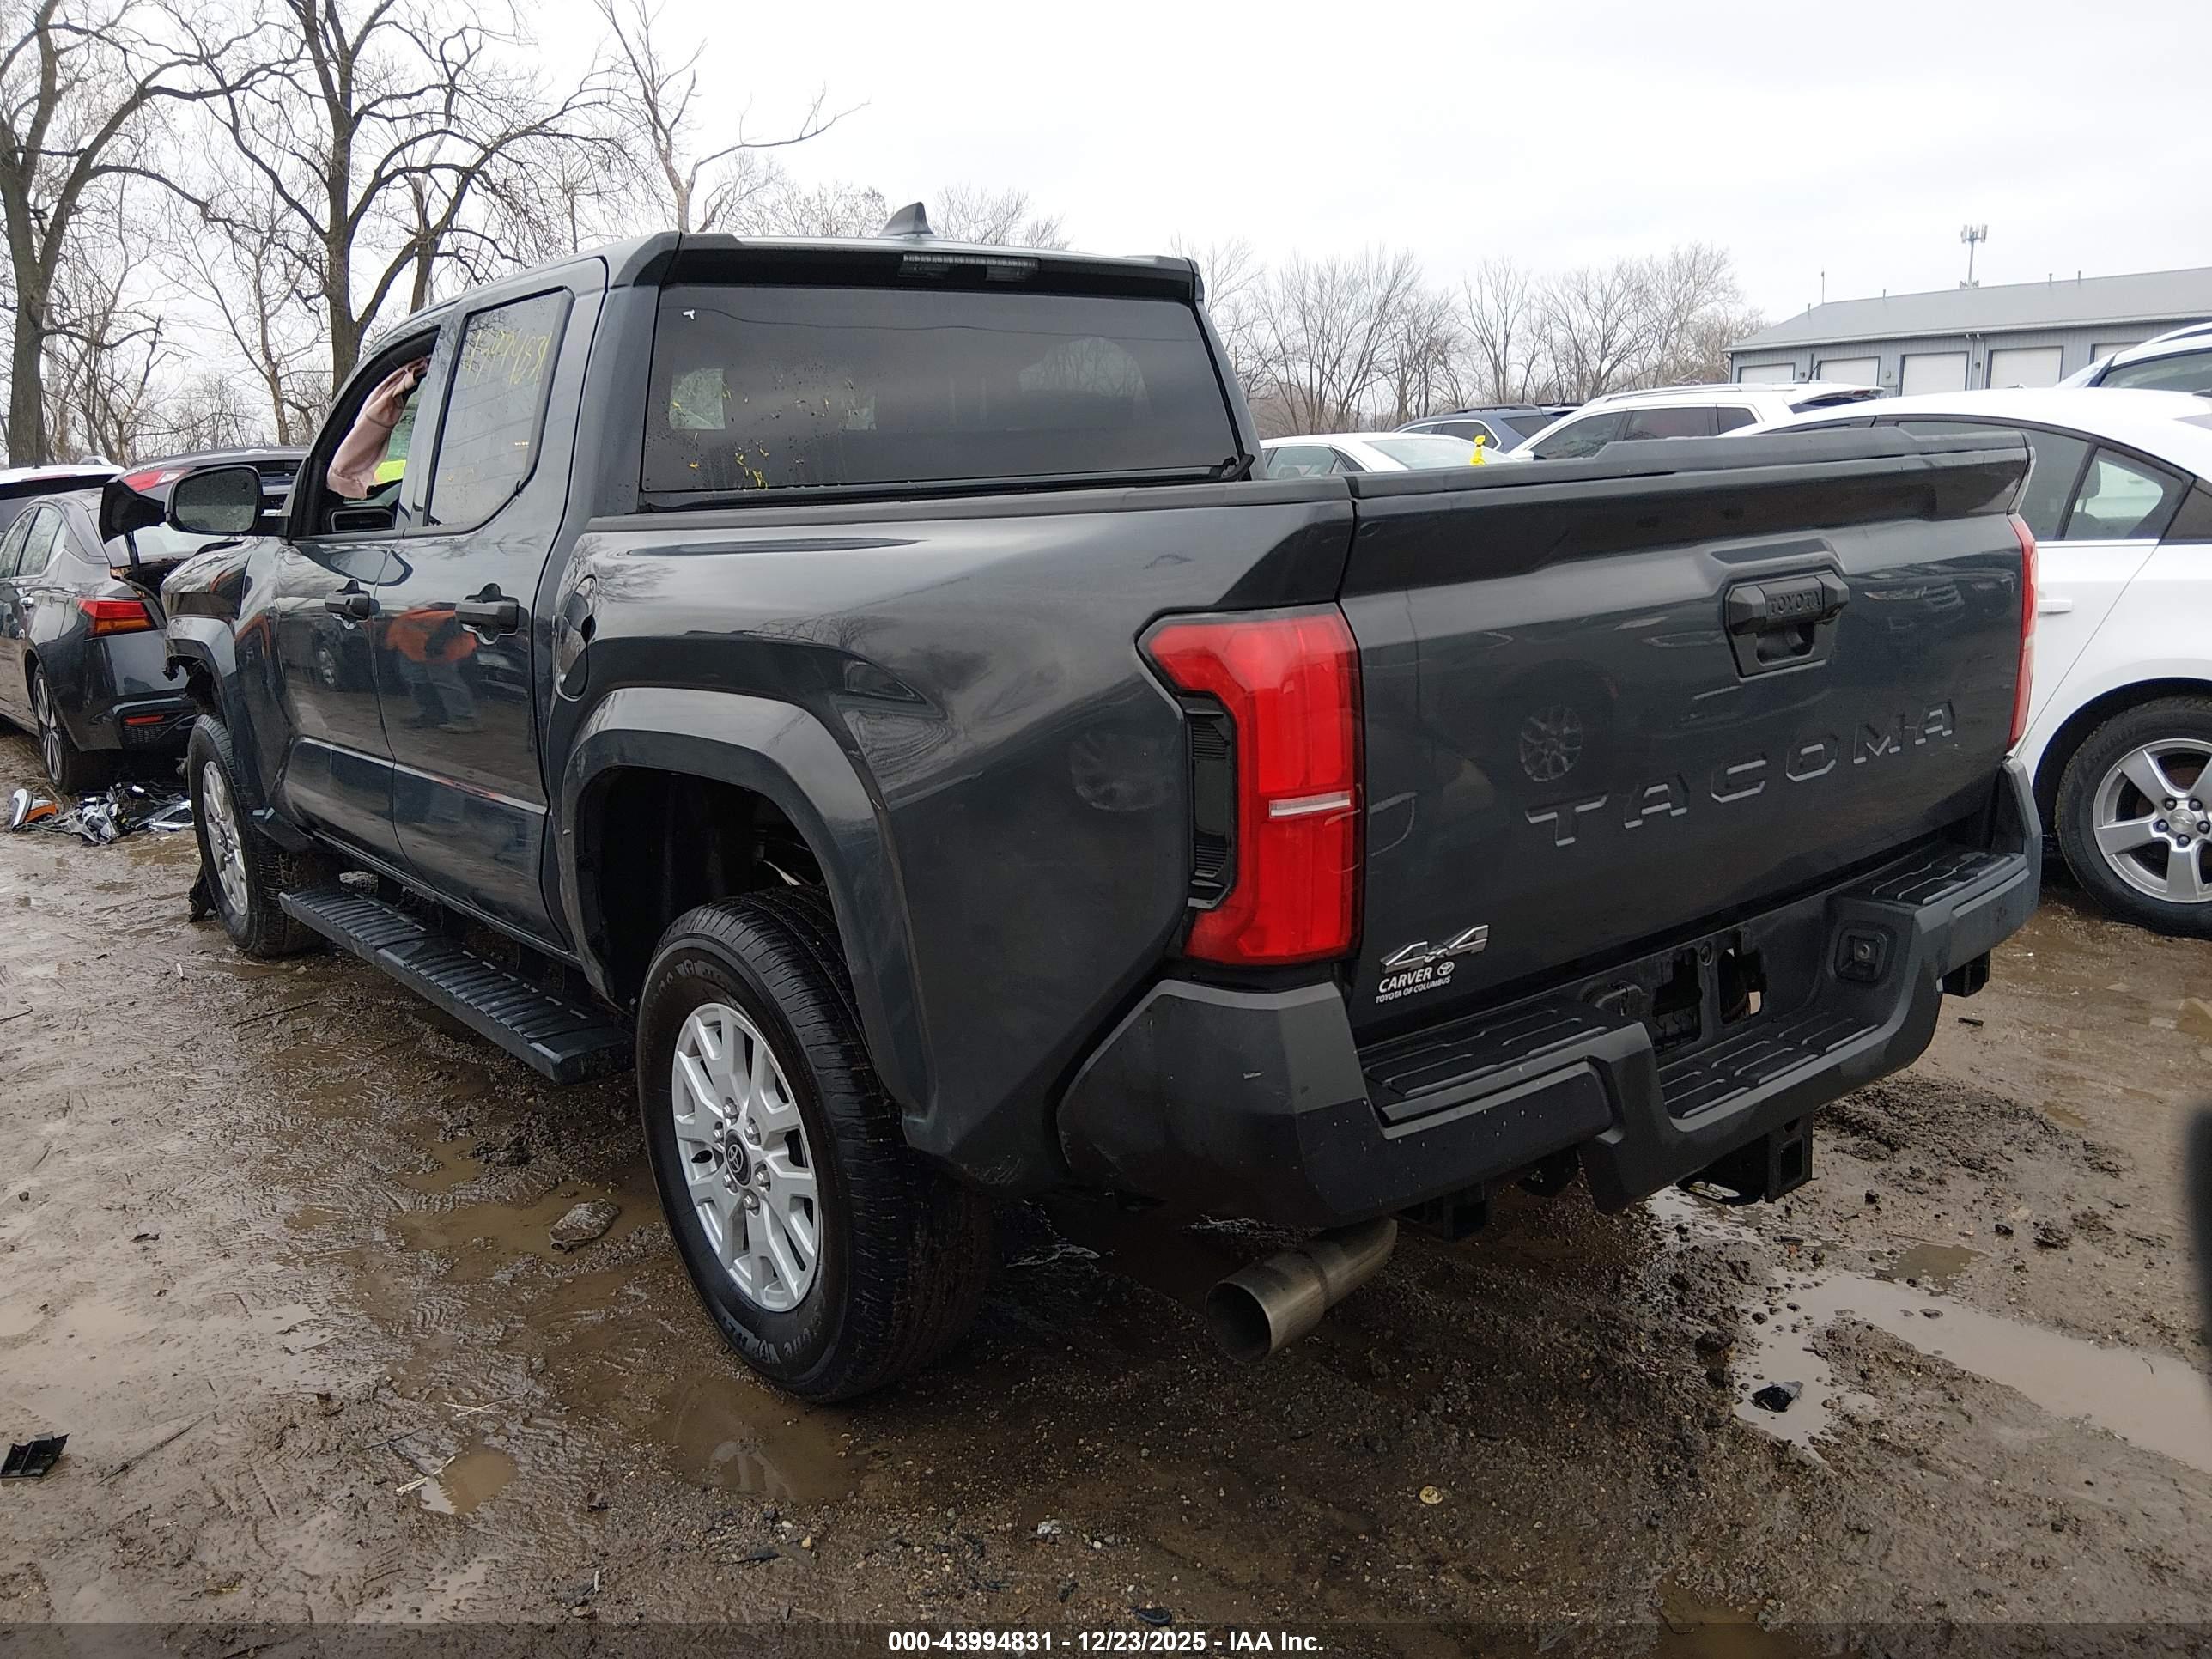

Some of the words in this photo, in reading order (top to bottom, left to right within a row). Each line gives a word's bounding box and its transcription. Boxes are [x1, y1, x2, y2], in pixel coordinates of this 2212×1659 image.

[1770, 590, 1822, 616] TOYOTA
[1525, 699, 1956, 847] TACOMA
[1376, 990, 1402, 1003] TOYOTA
[1403, 987, 1413, 996] OF
[1413, 976, 1452, 993] COLUMBUS
[1378, 967, 1433, 993] CARVER
